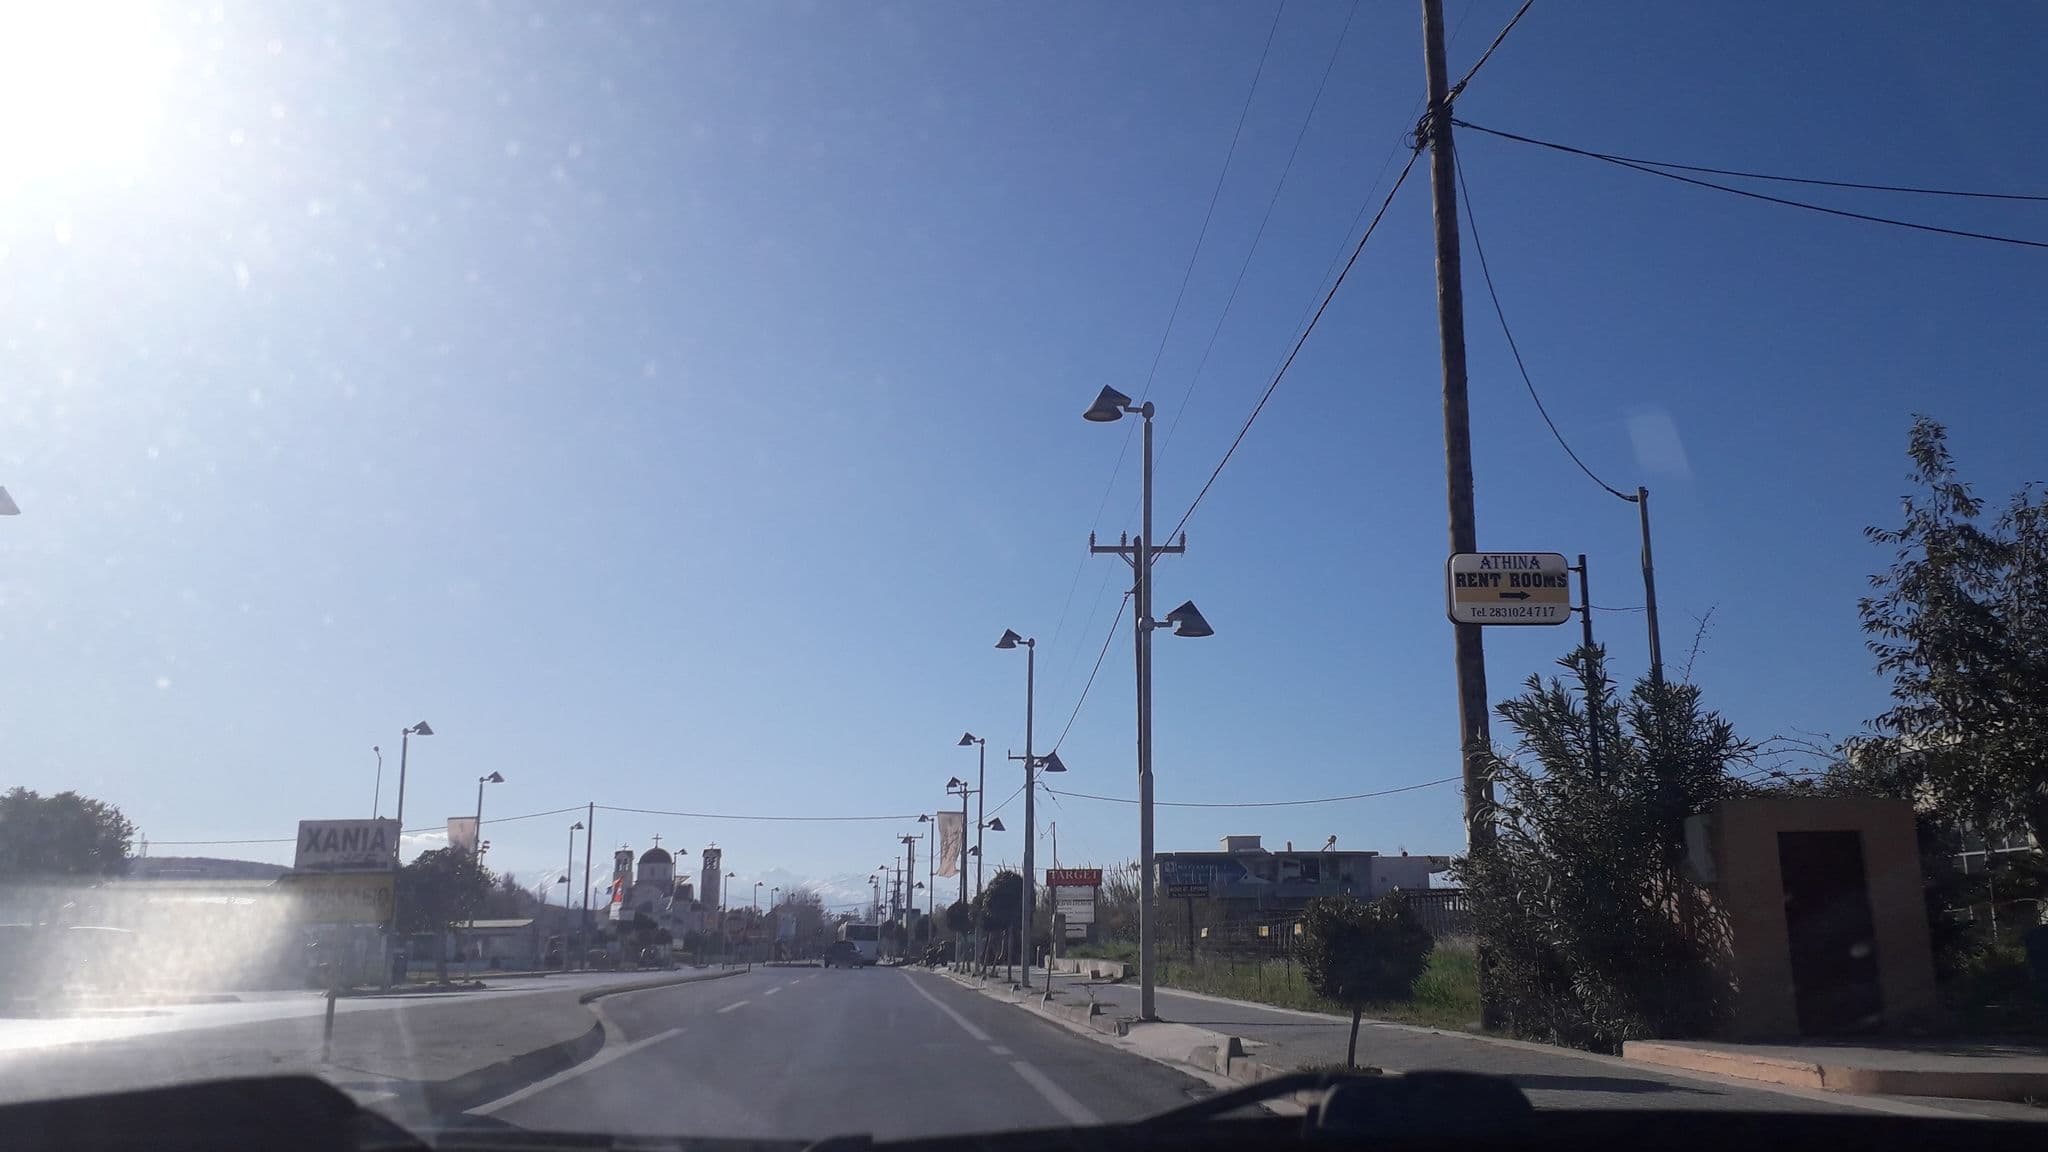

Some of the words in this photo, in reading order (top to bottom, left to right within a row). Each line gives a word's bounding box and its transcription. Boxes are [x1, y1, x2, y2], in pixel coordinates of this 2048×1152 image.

[1479, 555, 1542, 569] ATHINA
[1455, 572, 1501, 588] RENT
[1509, 572, 1568, 588] ROOMS
[1490, 606, 1556, 618] 2831024717
[1048, 869, 1099, 880] TARGET
